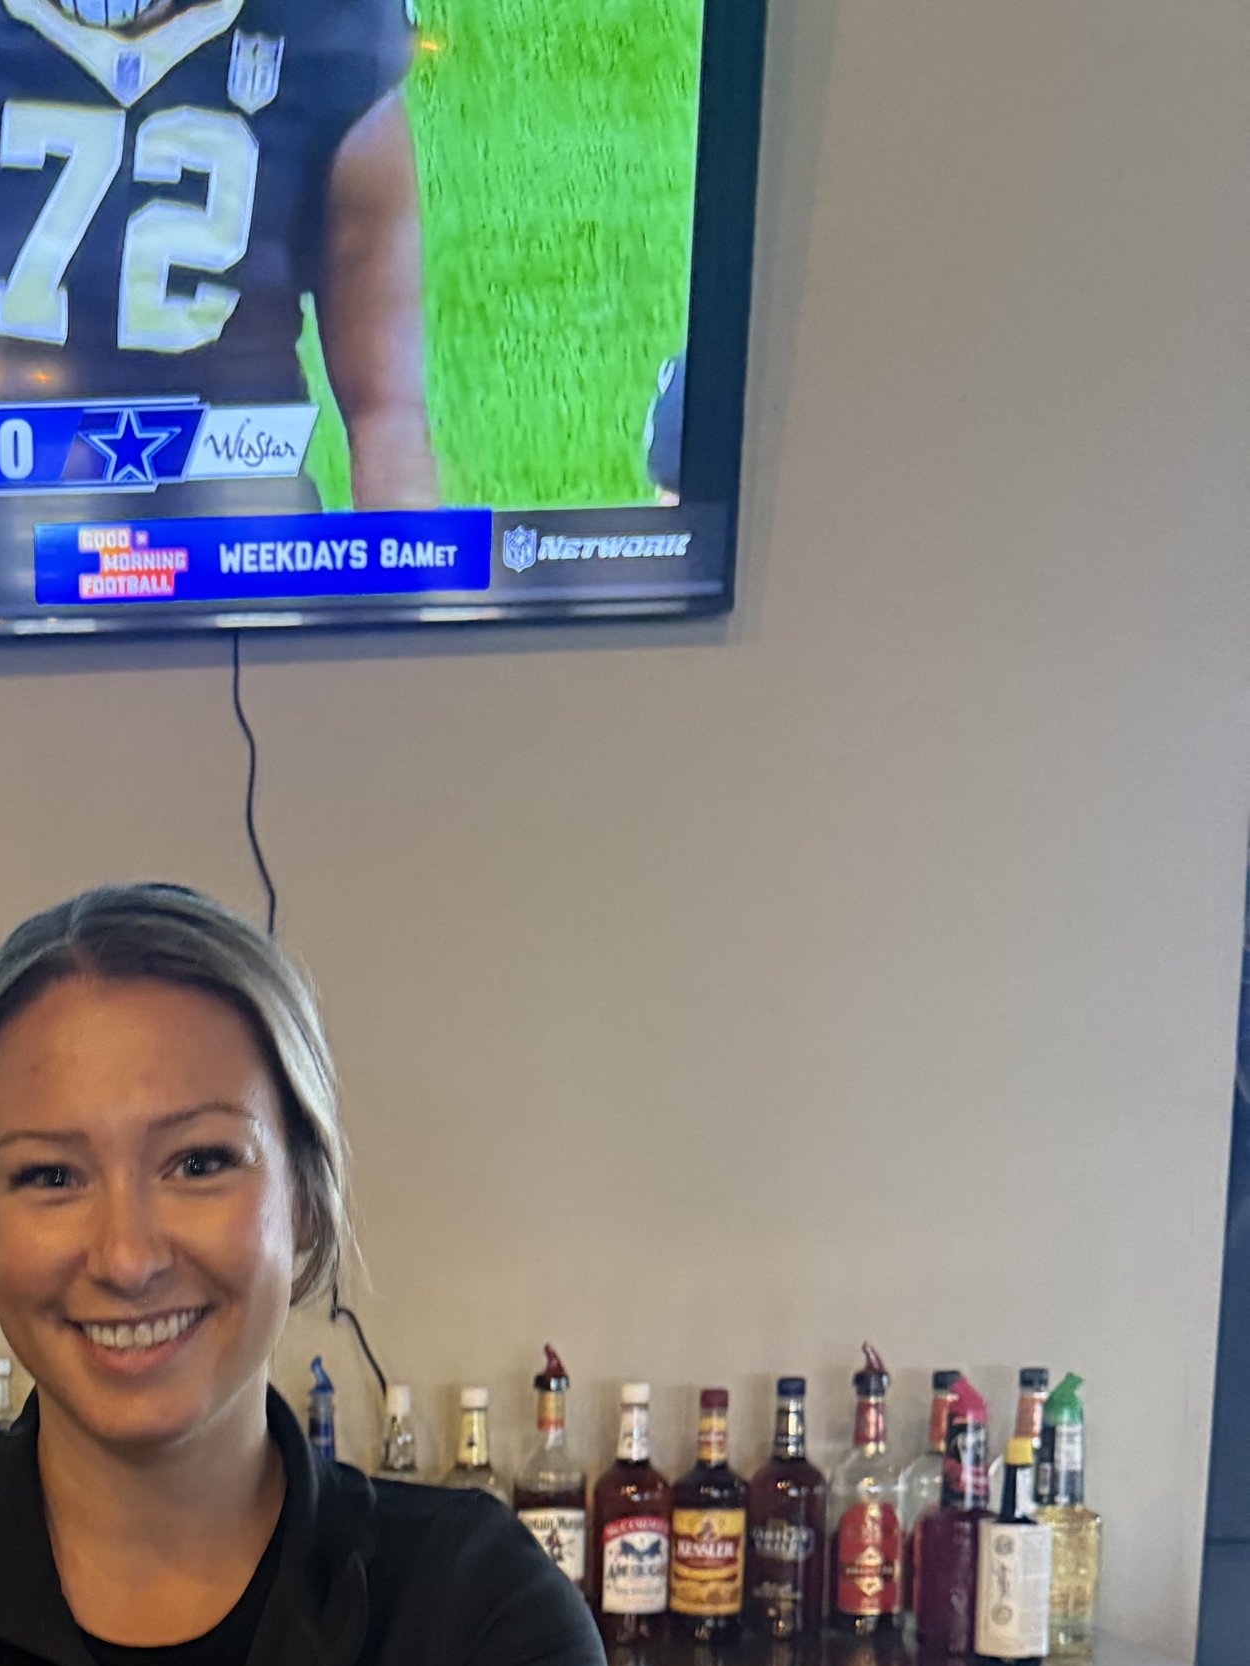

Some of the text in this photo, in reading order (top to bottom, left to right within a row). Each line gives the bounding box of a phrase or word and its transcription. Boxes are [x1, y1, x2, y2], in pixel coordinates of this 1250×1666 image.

[205, 417, 296, 467] WinStar
[80, 529, 130, 549] GOOD
[102, 551, 187, 571] MORNING
[219, 540, 368, 574] WEEKDAYS
[81, 575, 173, 597] FOOTBALL
